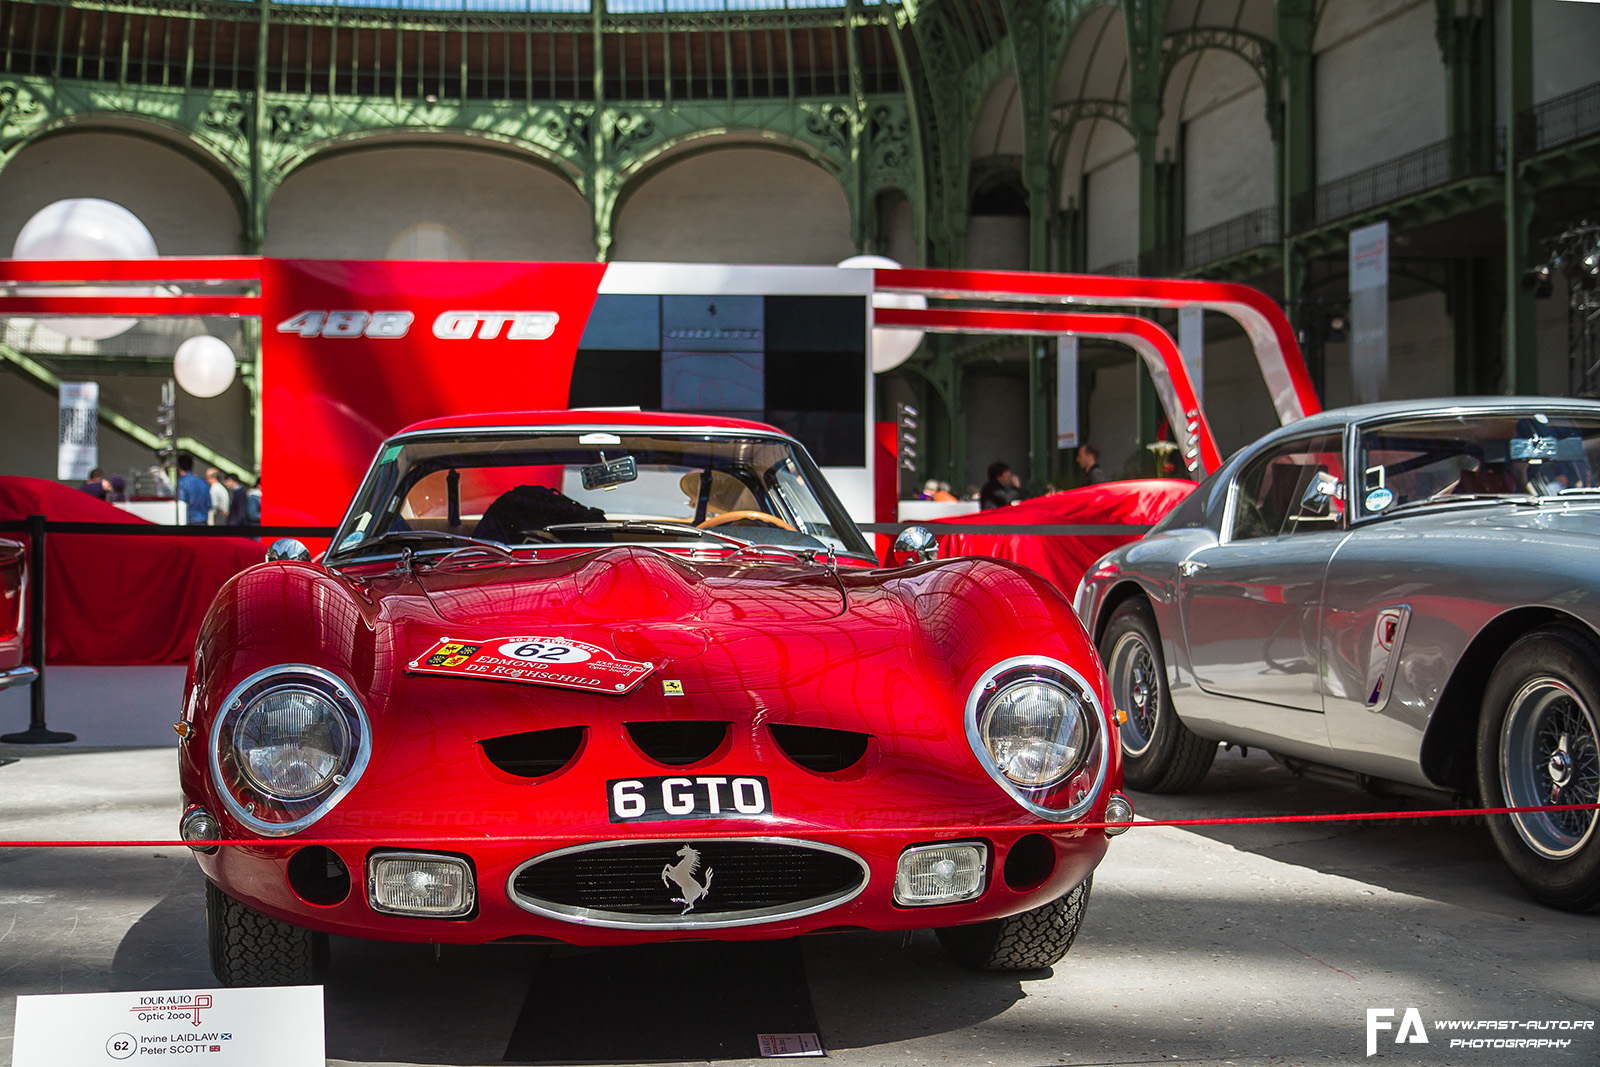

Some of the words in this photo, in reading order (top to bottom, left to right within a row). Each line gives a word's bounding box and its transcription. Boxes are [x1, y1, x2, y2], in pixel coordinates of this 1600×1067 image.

[276, 309, 415, 338] 488
[432, 310, 559, 340] GTB
[514, 643, 570, 661] 62
[475, 656, 548, 670] EDMOND
[465, 664, 489, 673] DE
[491, 665, 601, 686] ROTHSCHILD
[613, 780, 646, 818] 6
[661, 777, 765, 816] GTO
[140, 996, 164, 1005] TOUR
[166, 995, 192, 1004] AUTO
[138, 1012, 164, 1023] Optic
[167, 1011, 192, 1020] 2000
[140, 1034, 168, 1043] Irvine
[170, 1033, 219, 1043] LAIDLAW
[114, 1041, 129, 1051] 62
[140, 1046, 167, 1055] Peter
[169, 1045, 207, 1054] SCOTT
